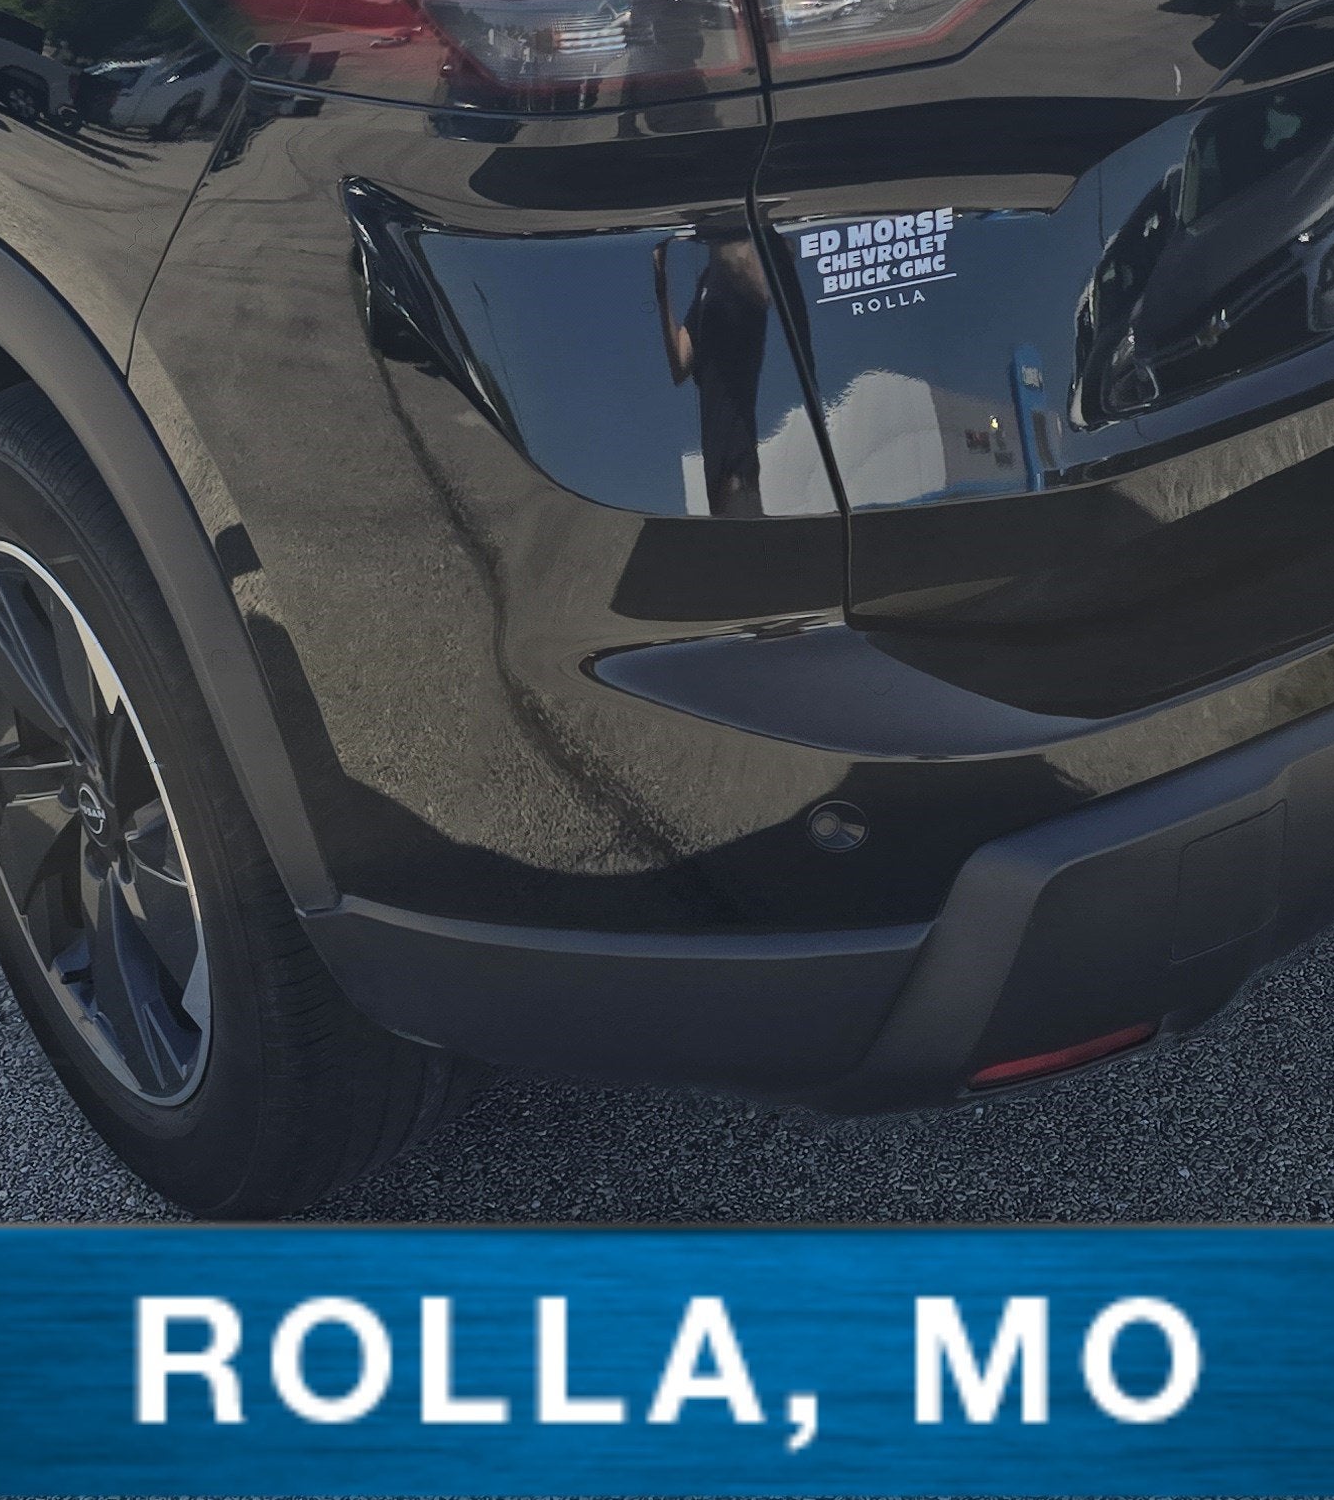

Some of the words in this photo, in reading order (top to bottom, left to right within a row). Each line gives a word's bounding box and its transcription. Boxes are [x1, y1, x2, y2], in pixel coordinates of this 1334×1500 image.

[800, 229, 841, 259] ED
[847, 207, 954, 250] MORSE
[817, 233, 947, 275] CHEVROLET
[852, 290, 926, 315] ROLLA
